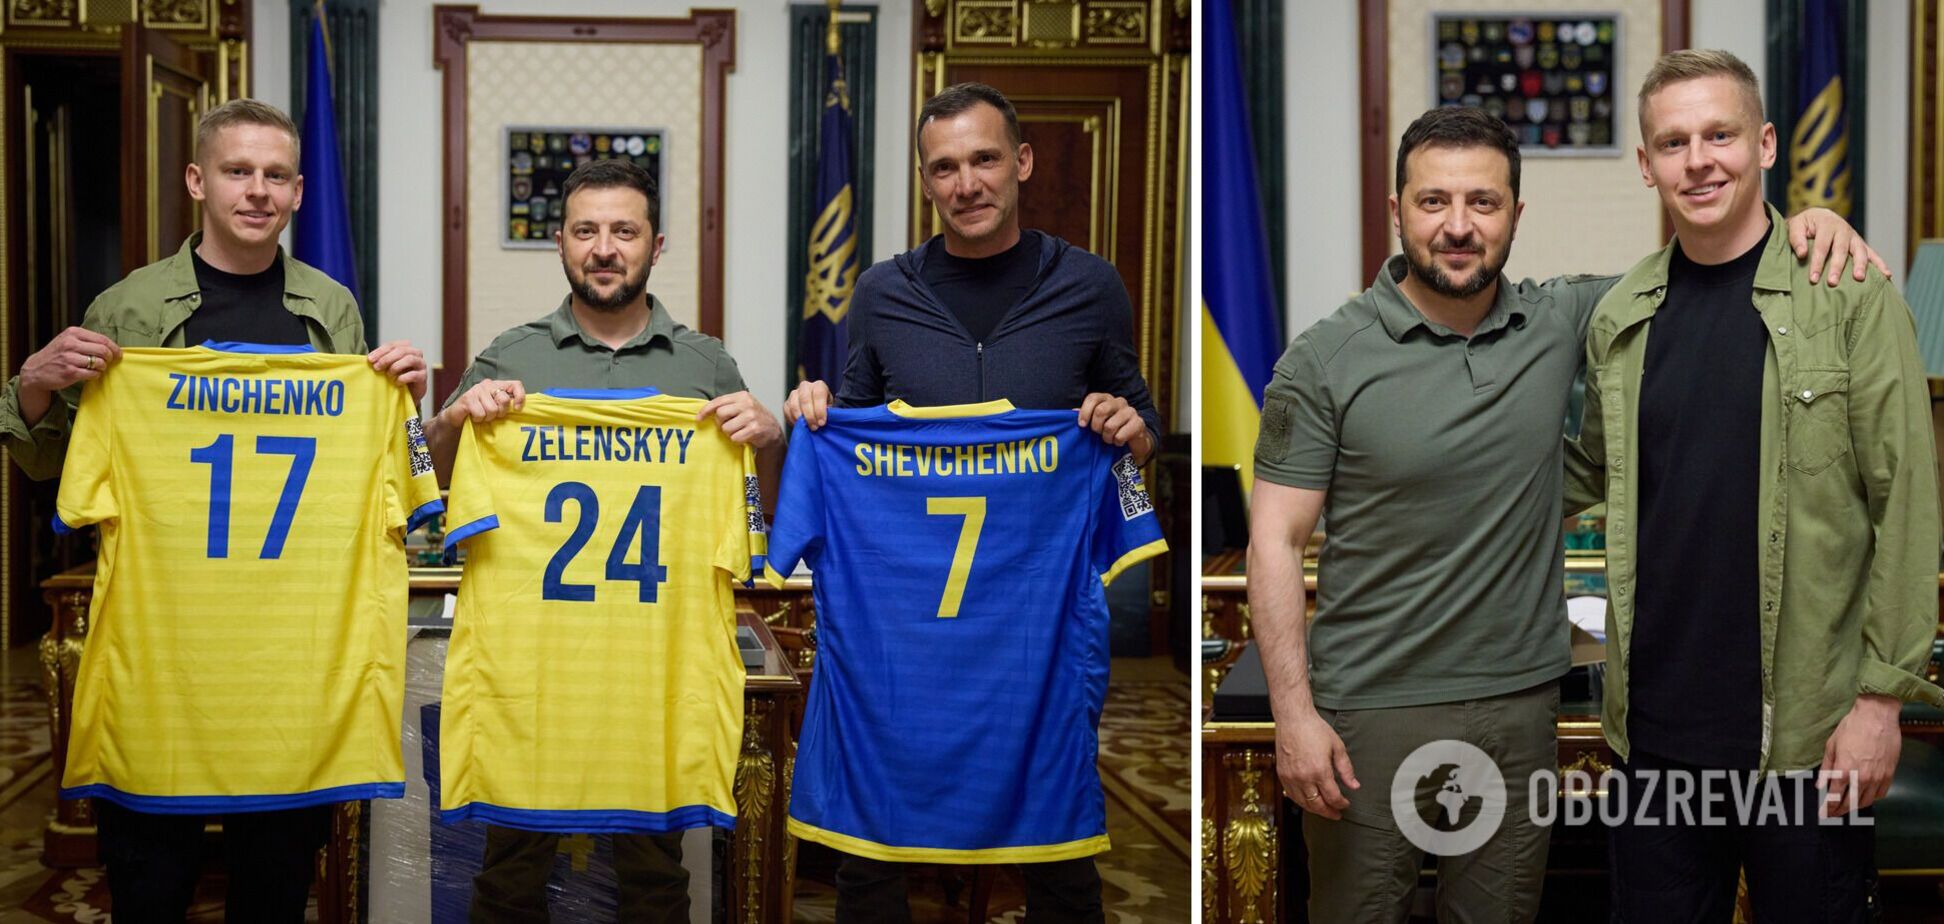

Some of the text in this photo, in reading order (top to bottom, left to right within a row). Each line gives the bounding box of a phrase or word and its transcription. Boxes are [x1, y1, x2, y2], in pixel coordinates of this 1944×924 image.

[167, 373, 344, 417] ZINCHENKO
[520, 426, 694, 464] ZELENSKYY
[855, 436, 1059, 477] SHEVCHENKO
[190, 433, 317, 560] 17
[542, 481, 667, 603] 24
[926, 496, 987, 618] 7
